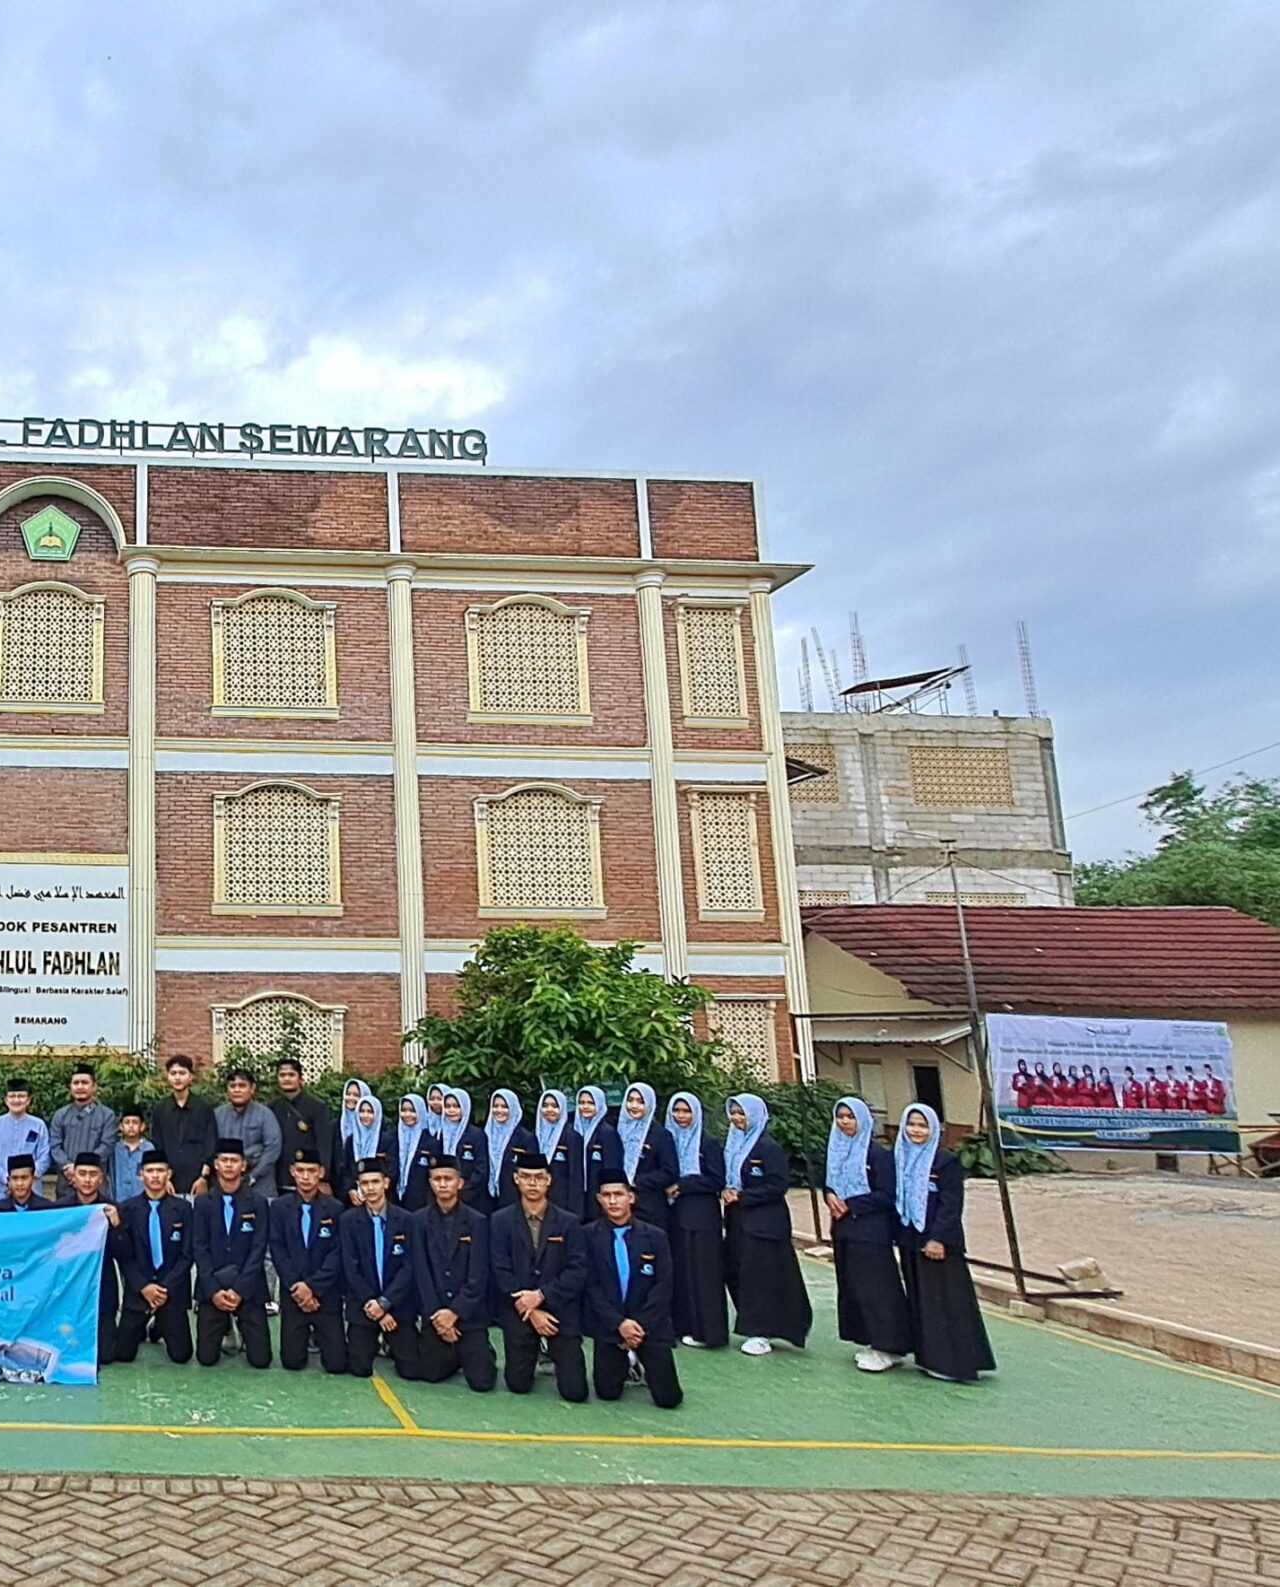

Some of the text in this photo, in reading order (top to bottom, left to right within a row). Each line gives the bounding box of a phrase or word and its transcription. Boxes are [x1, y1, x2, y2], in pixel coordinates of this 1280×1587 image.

[22, 417, 225, 453] FADHLAN
[238, 422, 489, 461] SEMARANG
[32, 921, 118, 934] PESANTREN
[43, 951, 121, 976] FADHLAN
[14, 1016, 67, 1025] SEMARANG
